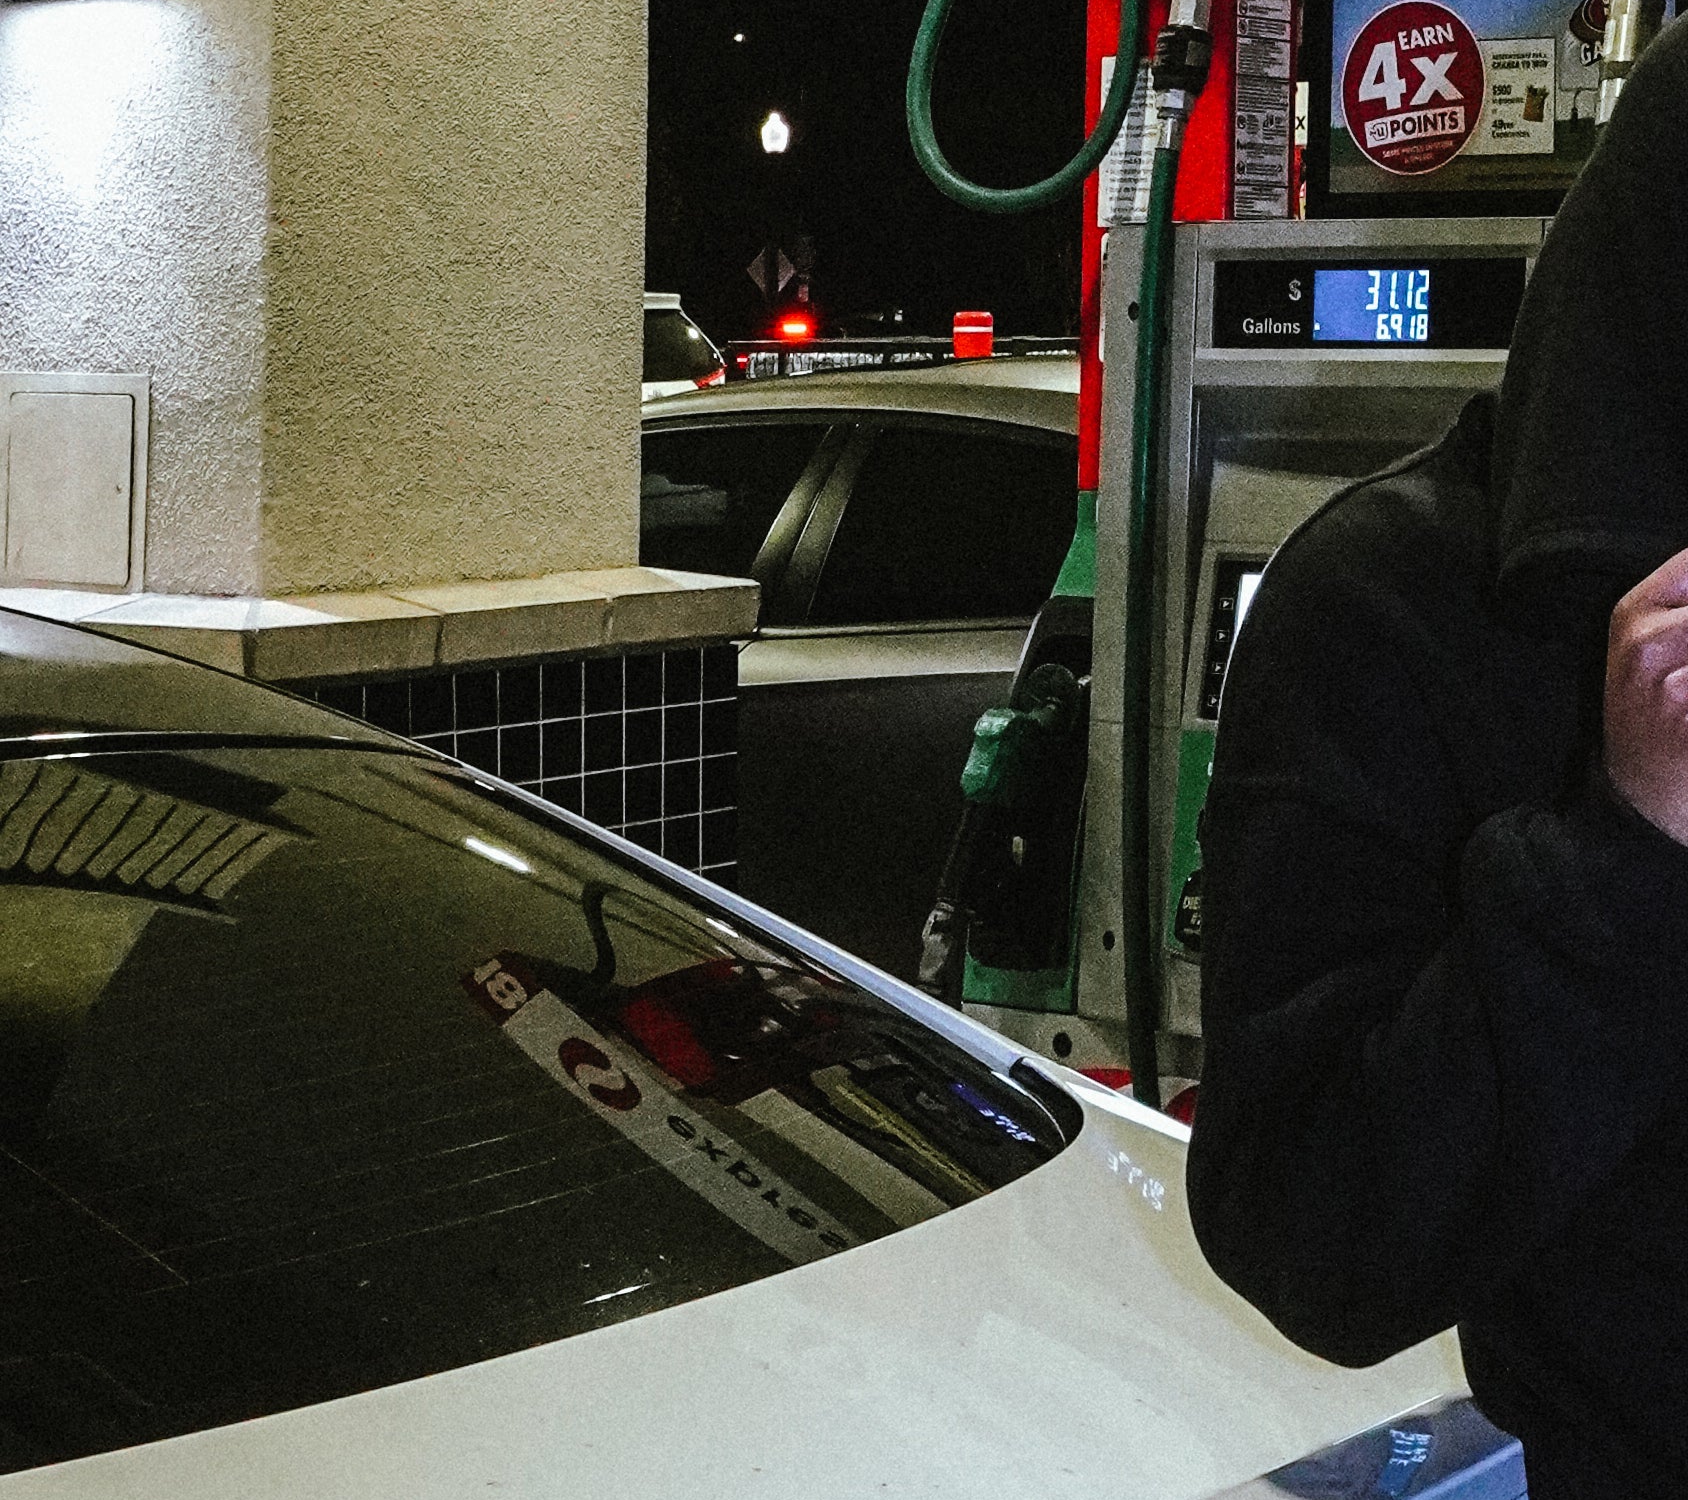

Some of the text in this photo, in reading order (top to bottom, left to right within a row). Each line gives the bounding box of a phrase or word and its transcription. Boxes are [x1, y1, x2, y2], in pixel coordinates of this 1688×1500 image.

[1398, 23, 1455, 52] EARN
[1390, 110, 1461, 139] POINTS
[1288, 278, 1302, 301] $
[1242, 317, 1302, 335] Gallons
